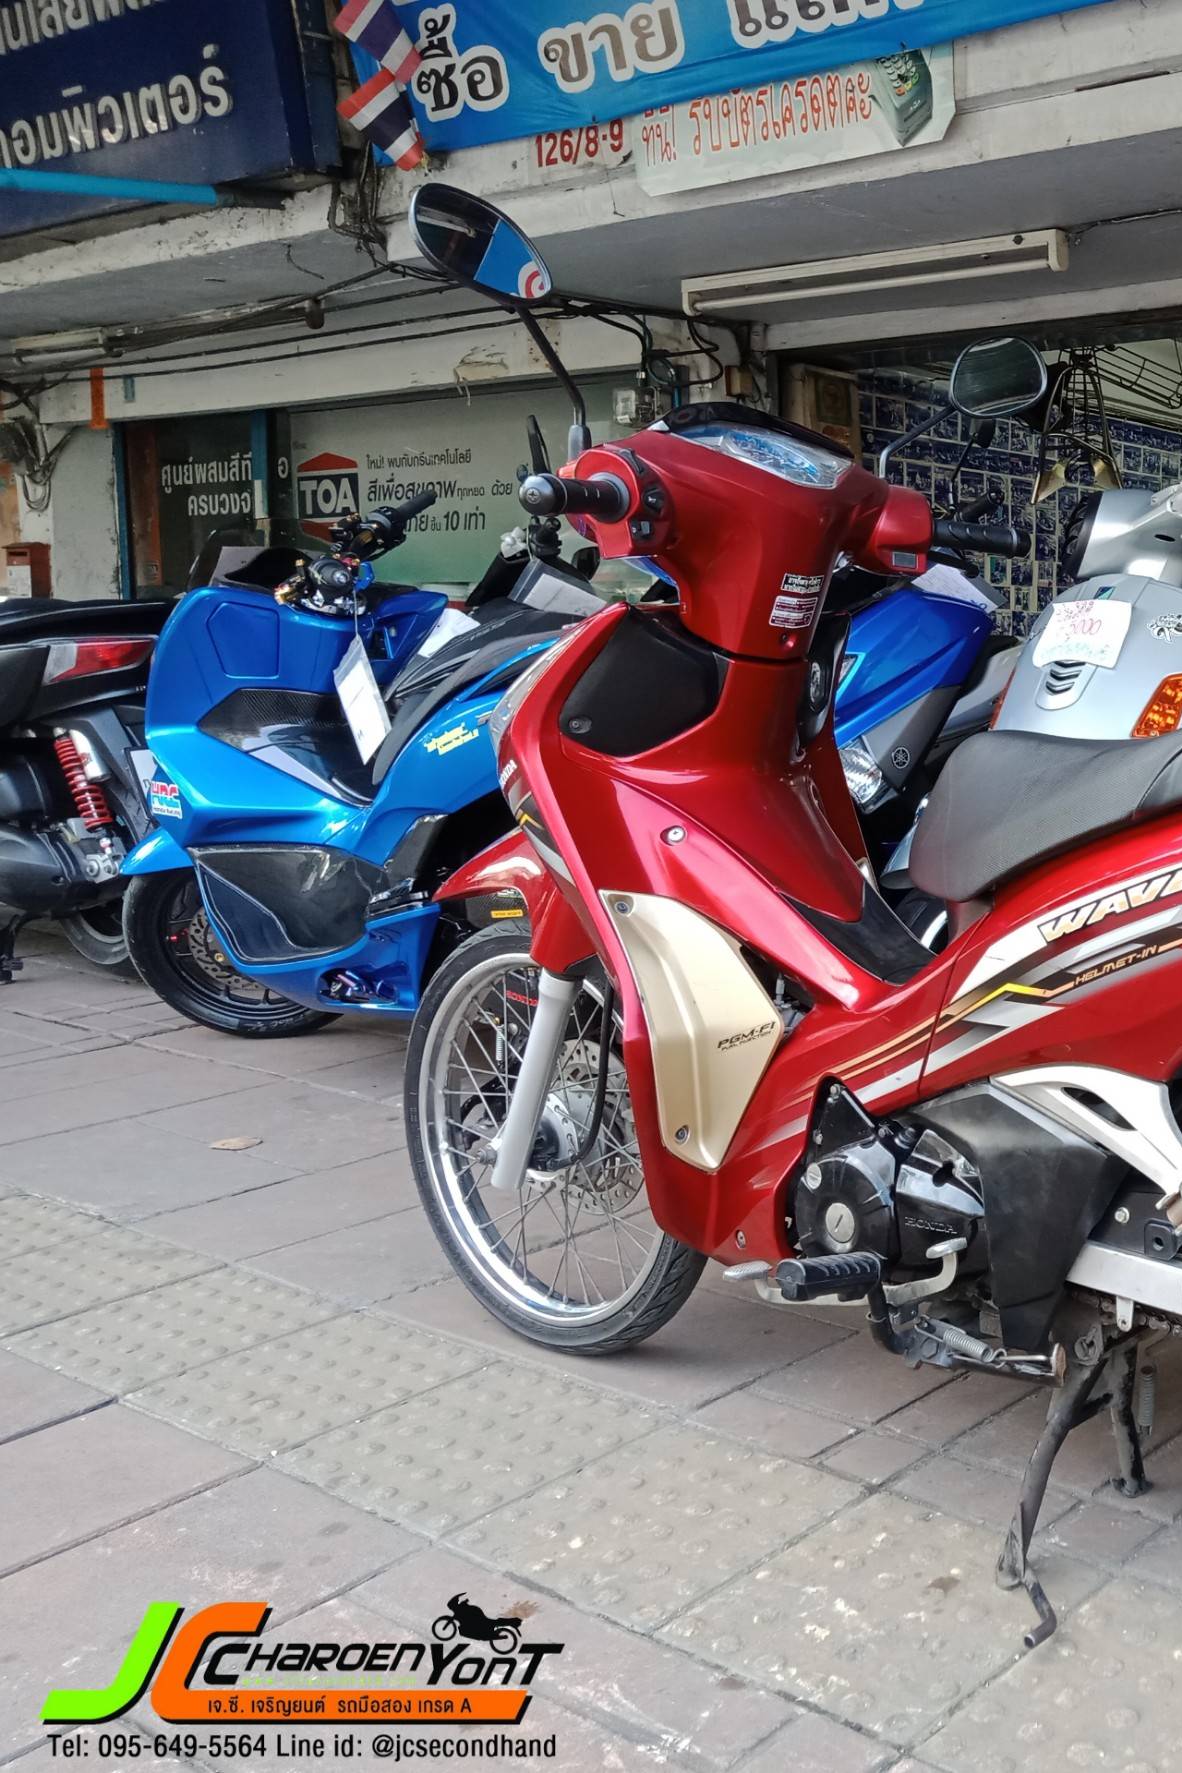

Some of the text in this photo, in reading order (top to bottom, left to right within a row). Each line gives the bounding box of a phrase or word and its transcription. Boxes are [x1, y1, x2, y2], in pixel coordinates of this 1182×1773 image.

[416, 14, 504, 112] ซื้อ
[543, 7, 678, 83] ขาย
[535, 119, 624, 167] 126/8-9
[300, 478, 357, 515] TOA
[491, 479, 513, 496] ด้วย
[187, 492, 264, 516] ครบวงจ
[443, 510, 460, 531] 10
[463, 506, 486, 531] เท่า
[1074, 943, 1158, 985] HELMET-IN
[717, 1021, 776, 1049] PGM-FI
